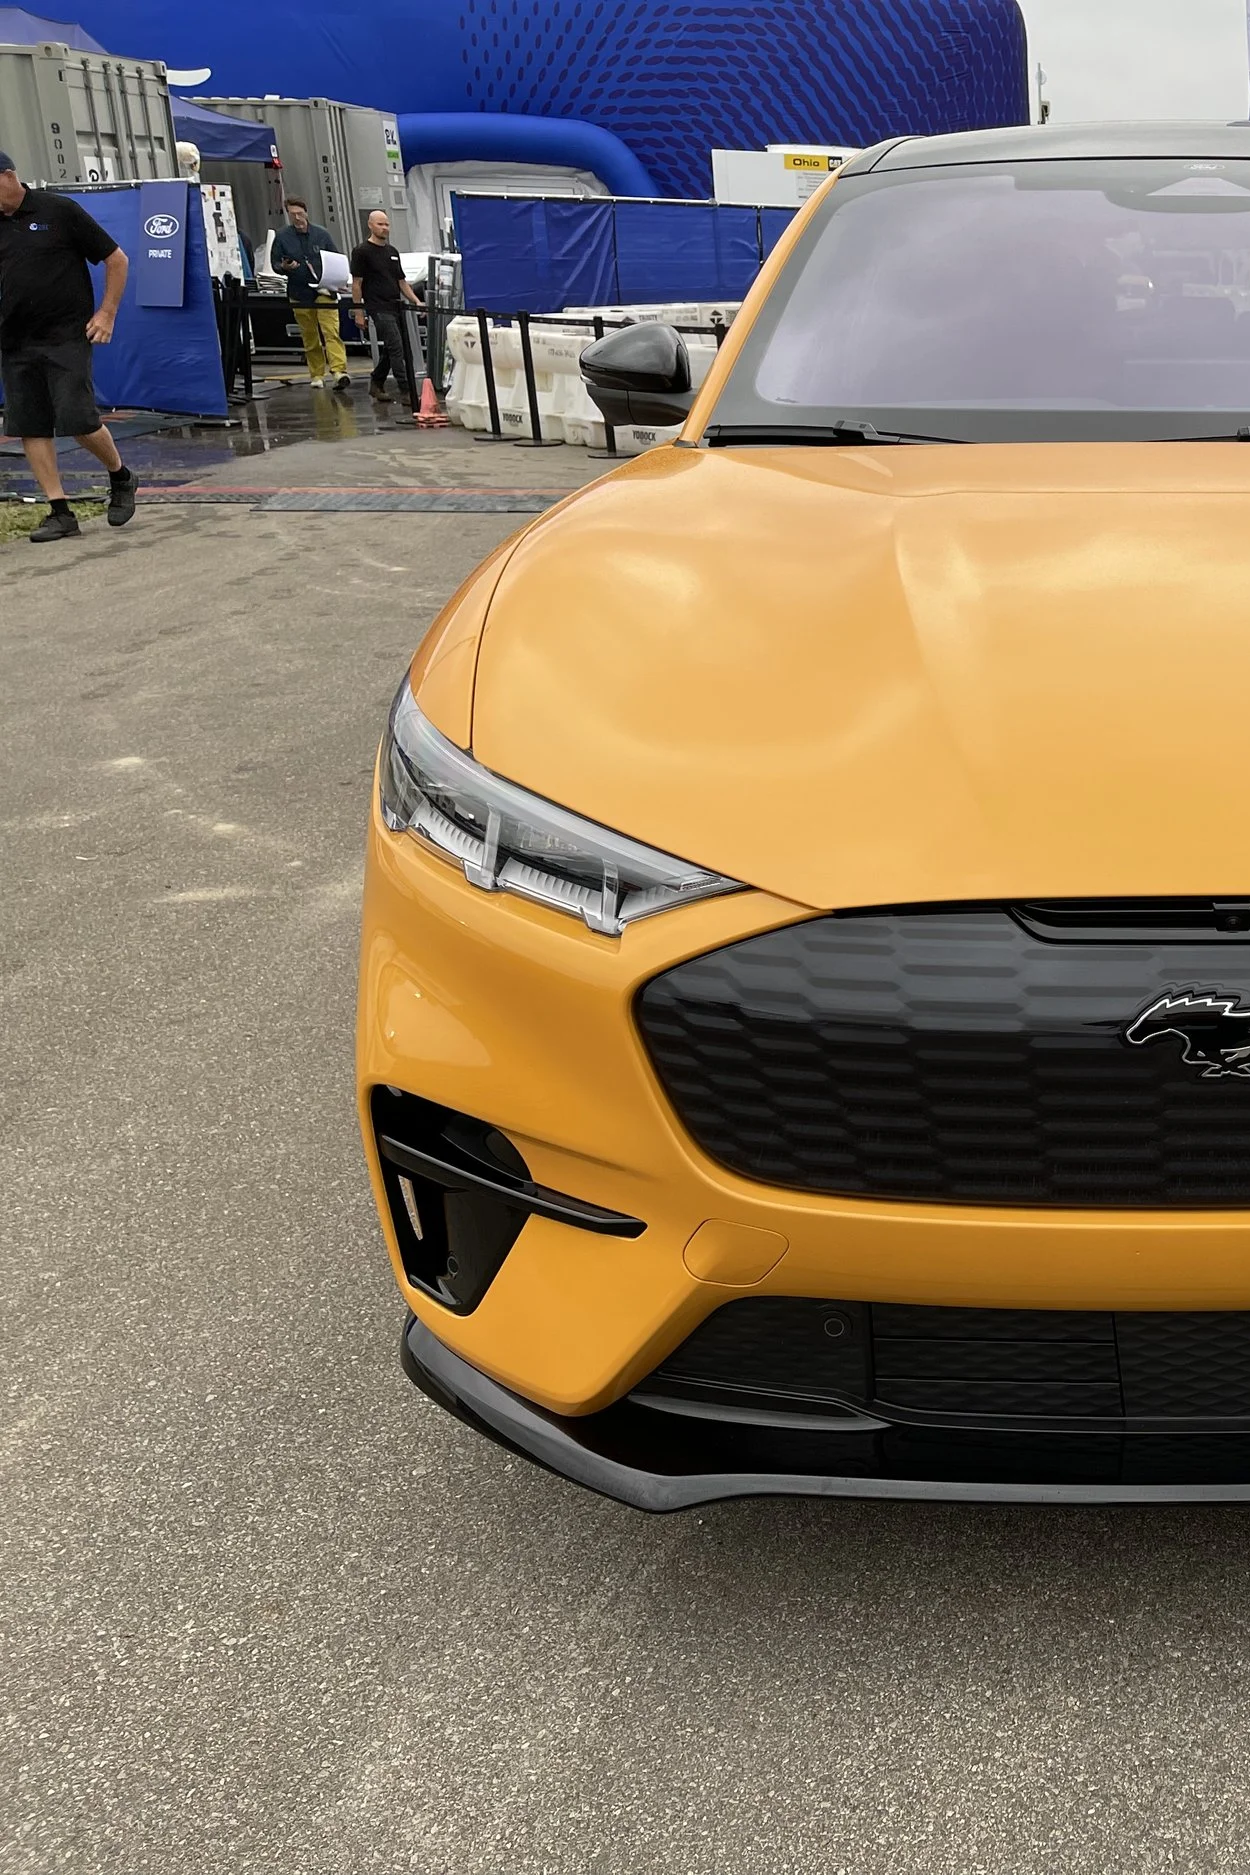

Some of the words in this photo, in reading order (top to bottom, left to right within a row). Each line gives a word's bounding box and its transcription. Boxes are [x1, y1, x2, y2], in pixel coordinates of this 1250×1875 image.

[792, 158, 820, 167] Ohio
[149, 217, 173, 235] Ford
[148, 249, 172, 259] PRIVATE
